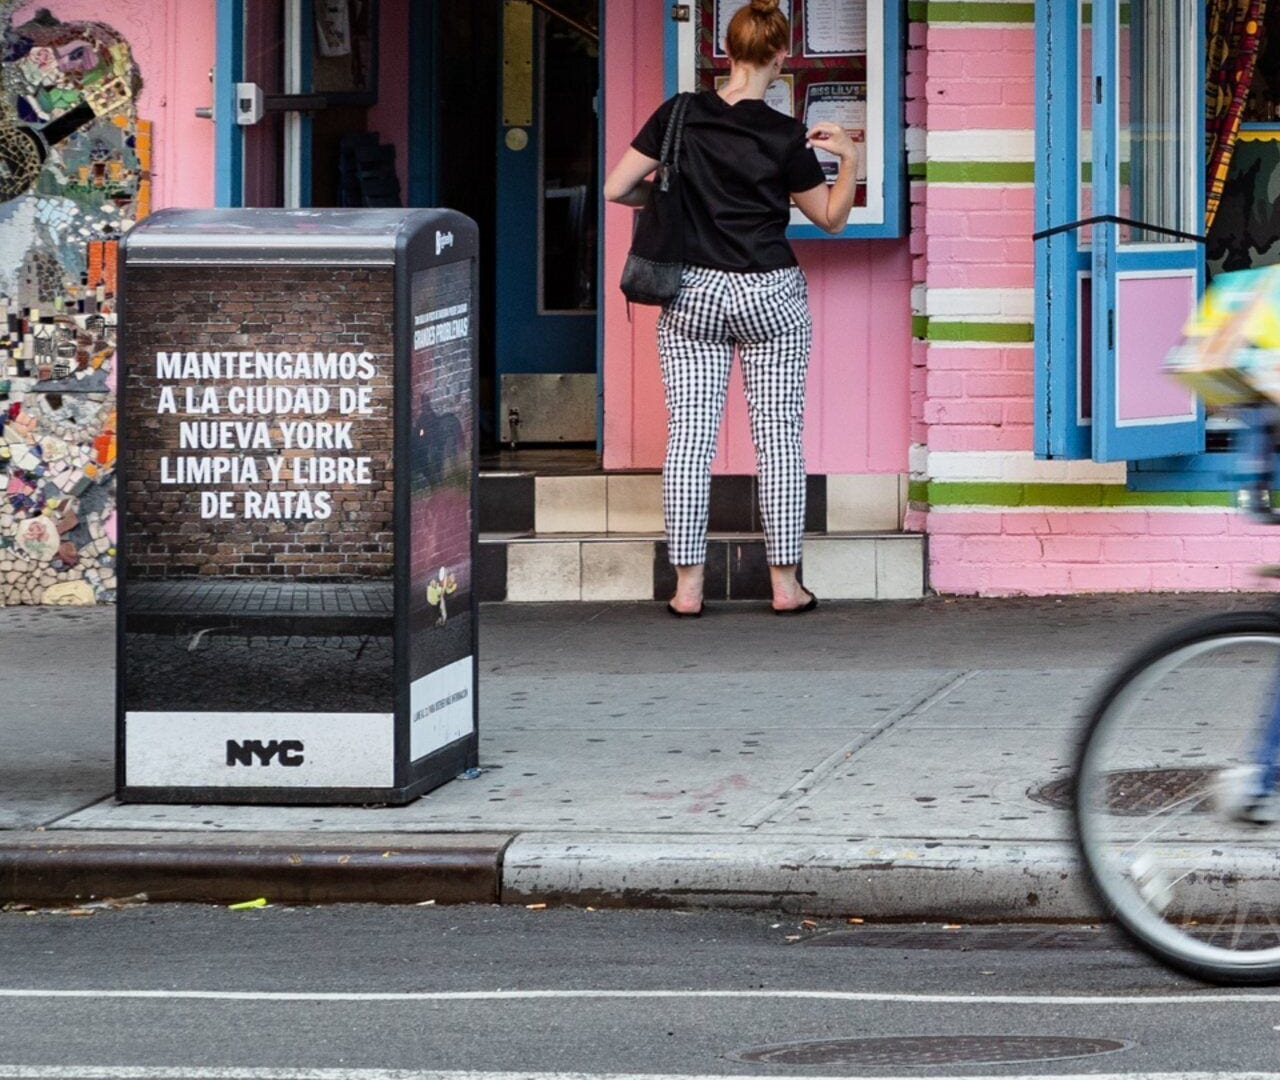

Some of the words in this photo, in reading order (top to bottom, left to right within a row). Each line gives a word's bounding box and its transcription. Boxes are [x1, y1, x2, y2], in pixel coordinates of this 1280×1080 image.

[156, 351, 376, 379] MANTENGAMOS
[157, 387, 177, 414] A
[185, 387, 220, 414] LA
[228, 386, 331, 414] CIUDAD
[339, 387, 374, 414] DE
[179, 422, 272, 449] NUEVA
[279, 422, 353, 449] YORK
[160, 456, 259, 484] LIMPIA
[266, 456, 285, 484] Y
[293, 456, 372, 484] LIBRE
[201, 491, 235, 519] DE
[244, 491, 332, 520] RATAS
[226, 739, 305, 767] NYC
